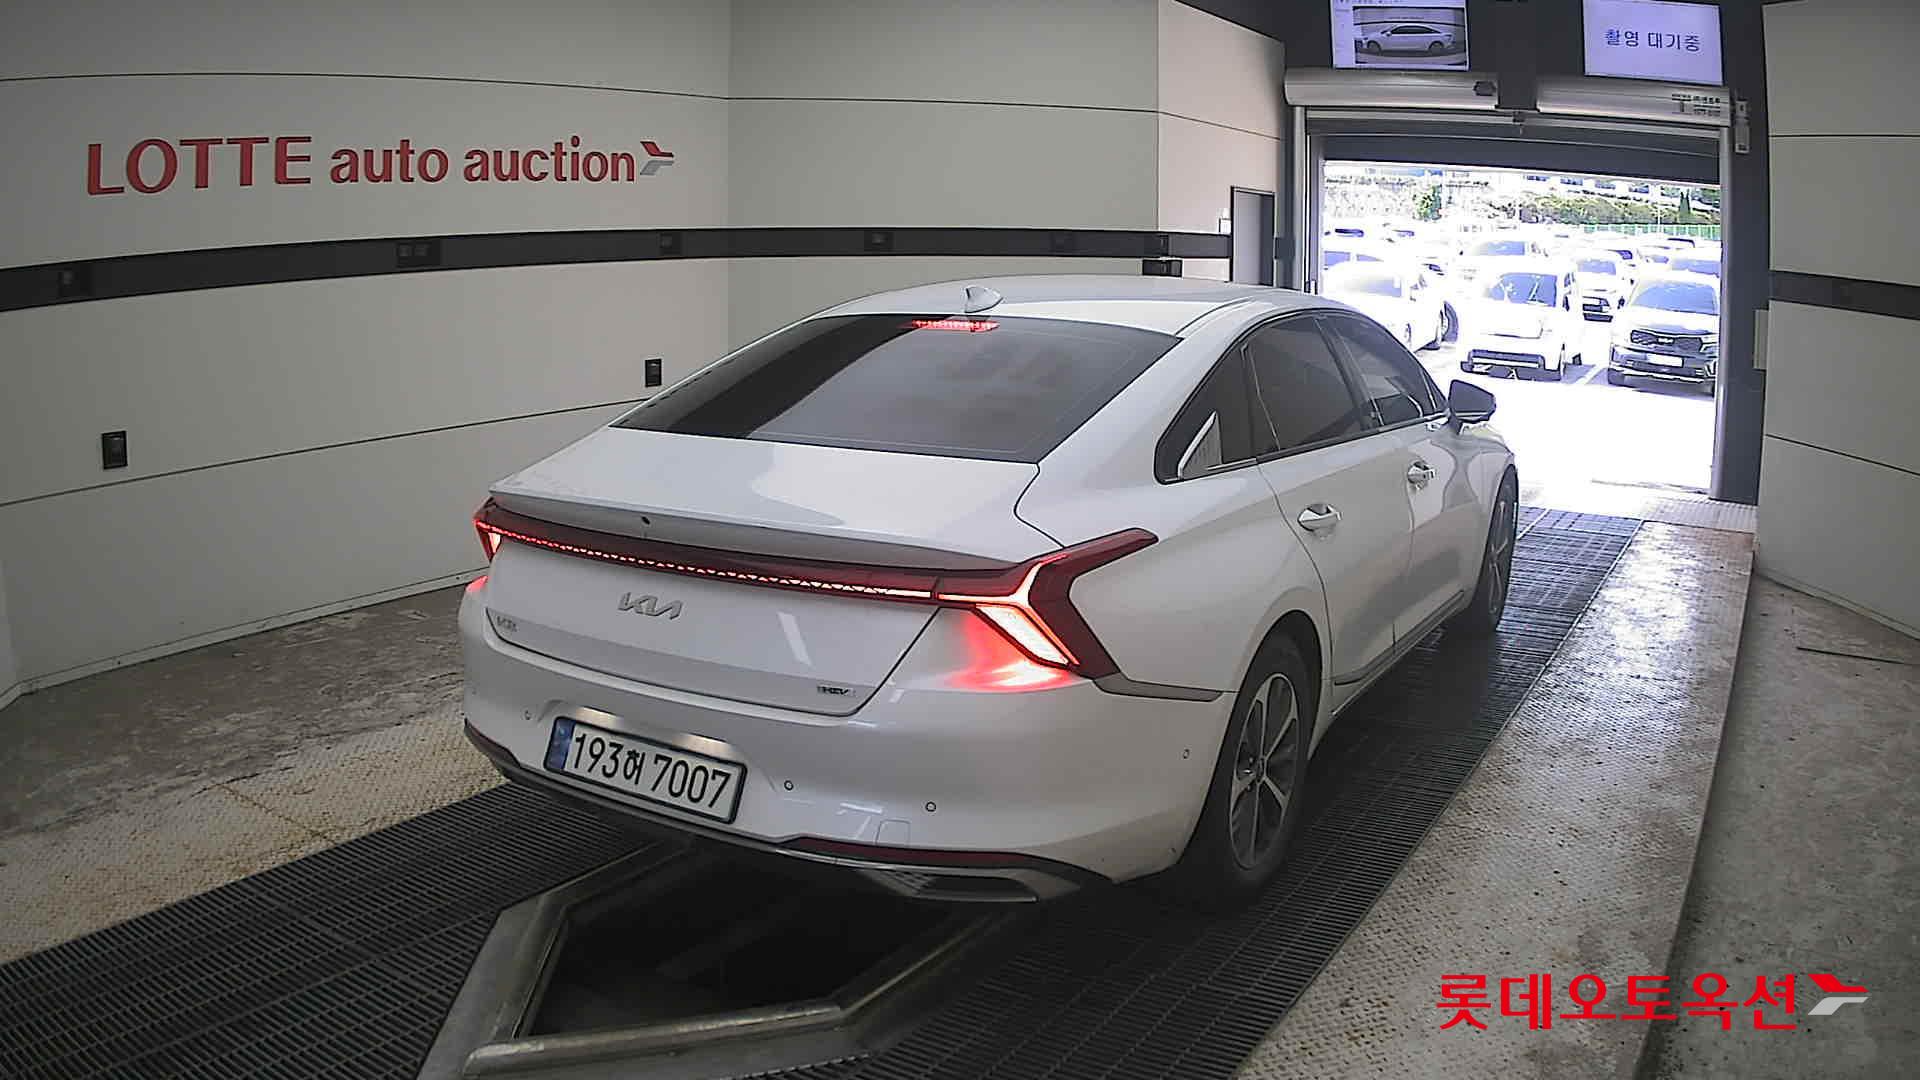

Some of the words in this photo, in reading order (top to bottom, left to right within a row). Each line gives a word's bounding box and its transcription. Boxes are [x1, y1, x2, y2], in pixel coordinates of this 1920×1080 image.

[1647, 31, 1701, 52] 대기중
[87, 135, 312, 195] LOTTE
[329, 138, 449, 184] auto
[463, 135, 636, 183] auction
[574, 733, 647, 786] 193허
[650, 753, 732, 808] 7007
